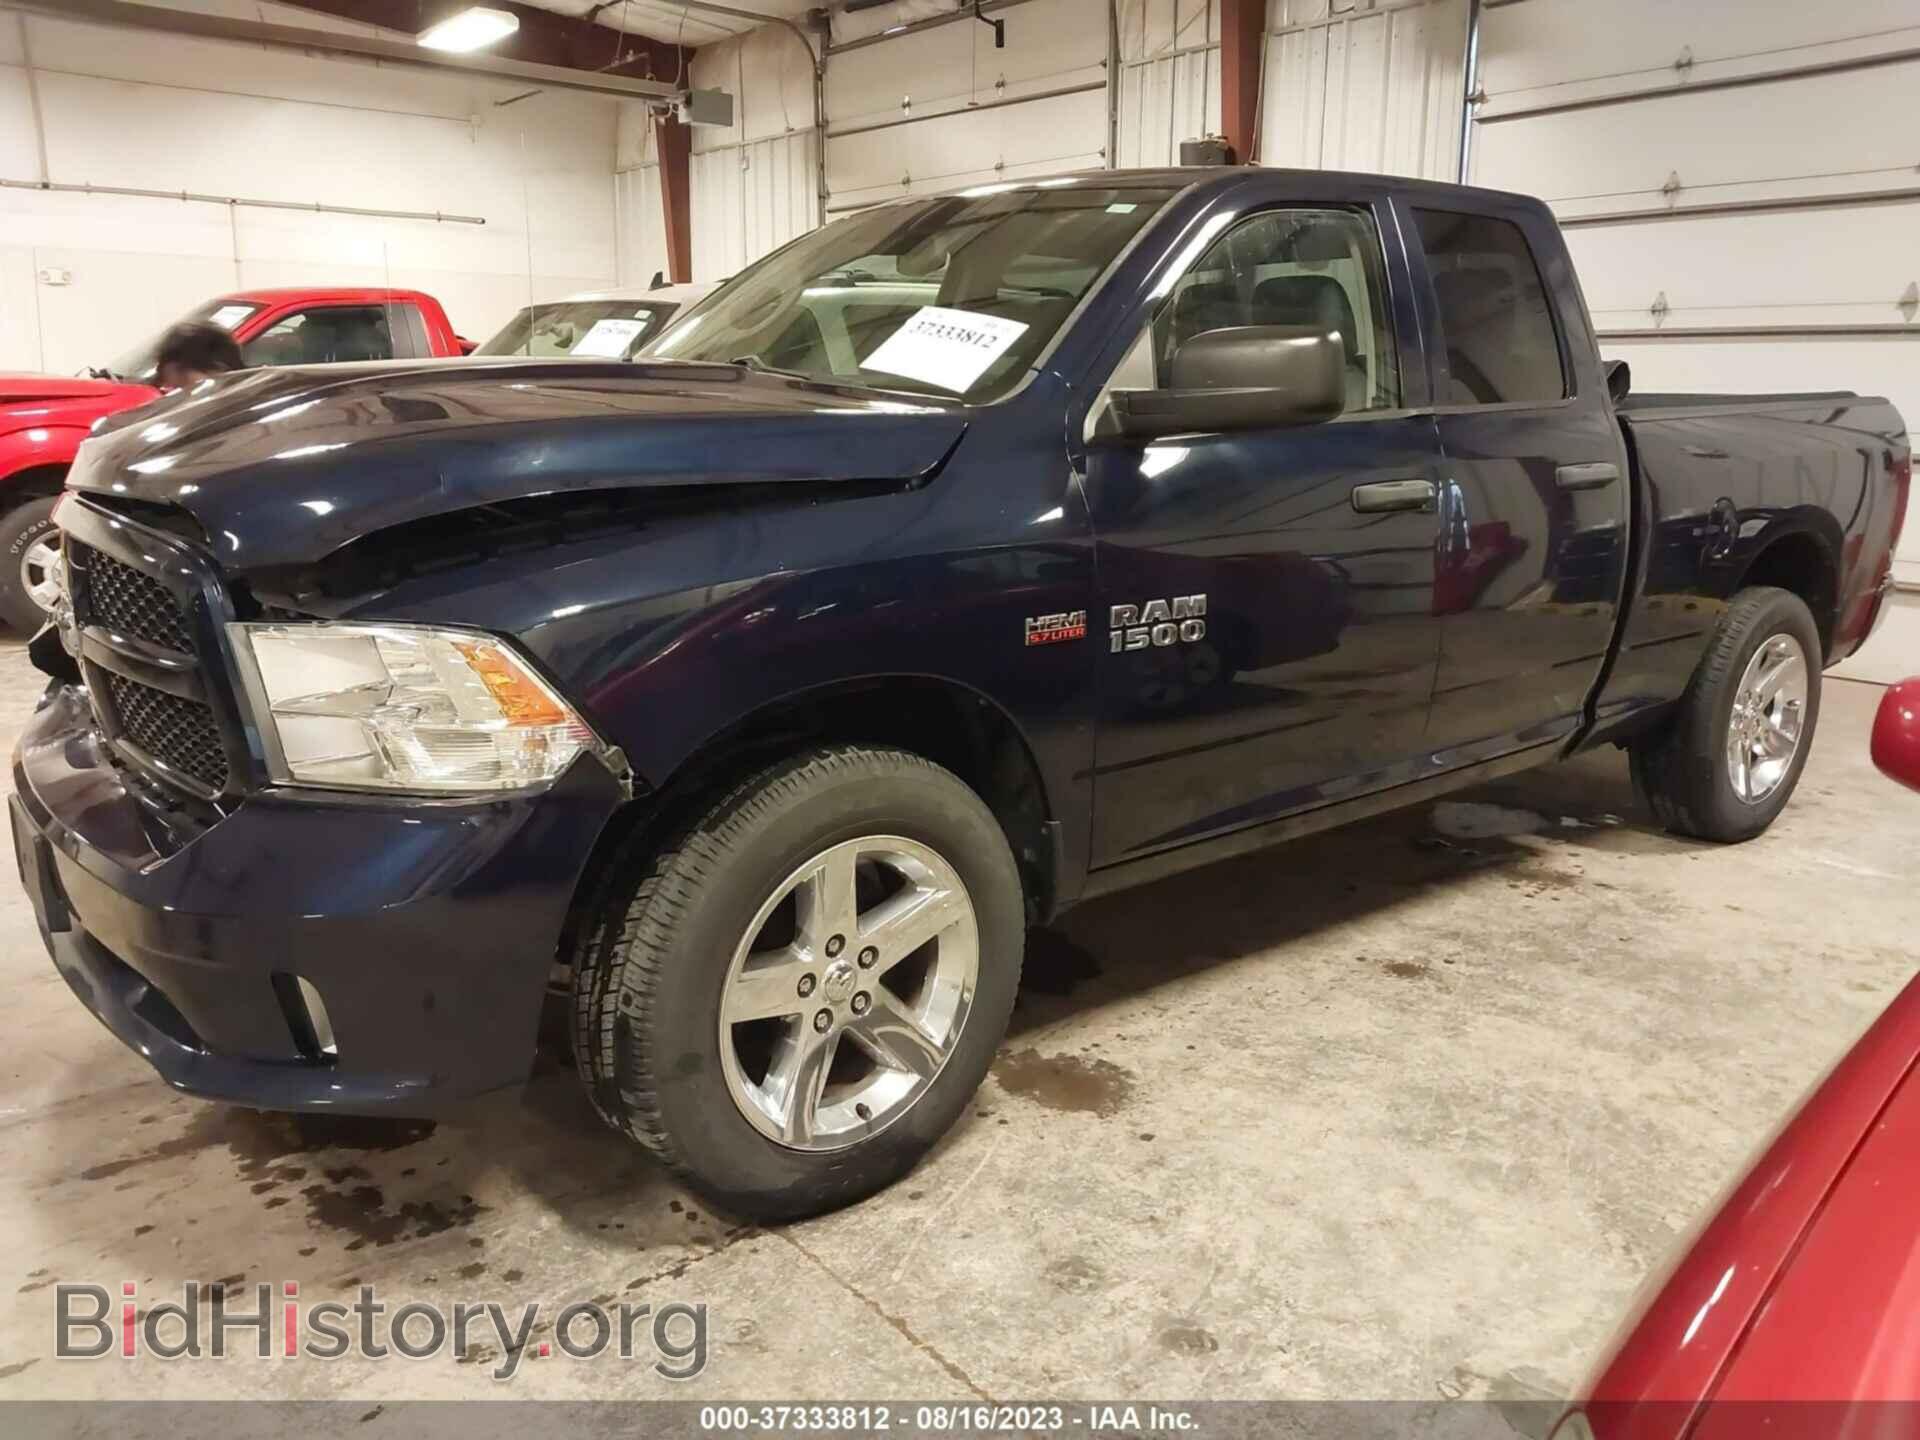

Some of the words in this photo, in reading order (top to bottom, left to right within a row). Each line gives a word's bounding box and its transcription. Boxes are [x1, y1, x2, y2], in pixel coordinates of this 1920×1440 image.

[909, 320, 998, 349] 37333812
[1025, 610, 1086, 634] HEMI
[1110, 594, 1207, 628] RAM
[1030, 631, 1048, 643] 5.7
[1051, 627, 1086, 641] LITER
[1109, 618, 1207, 653] 1500
